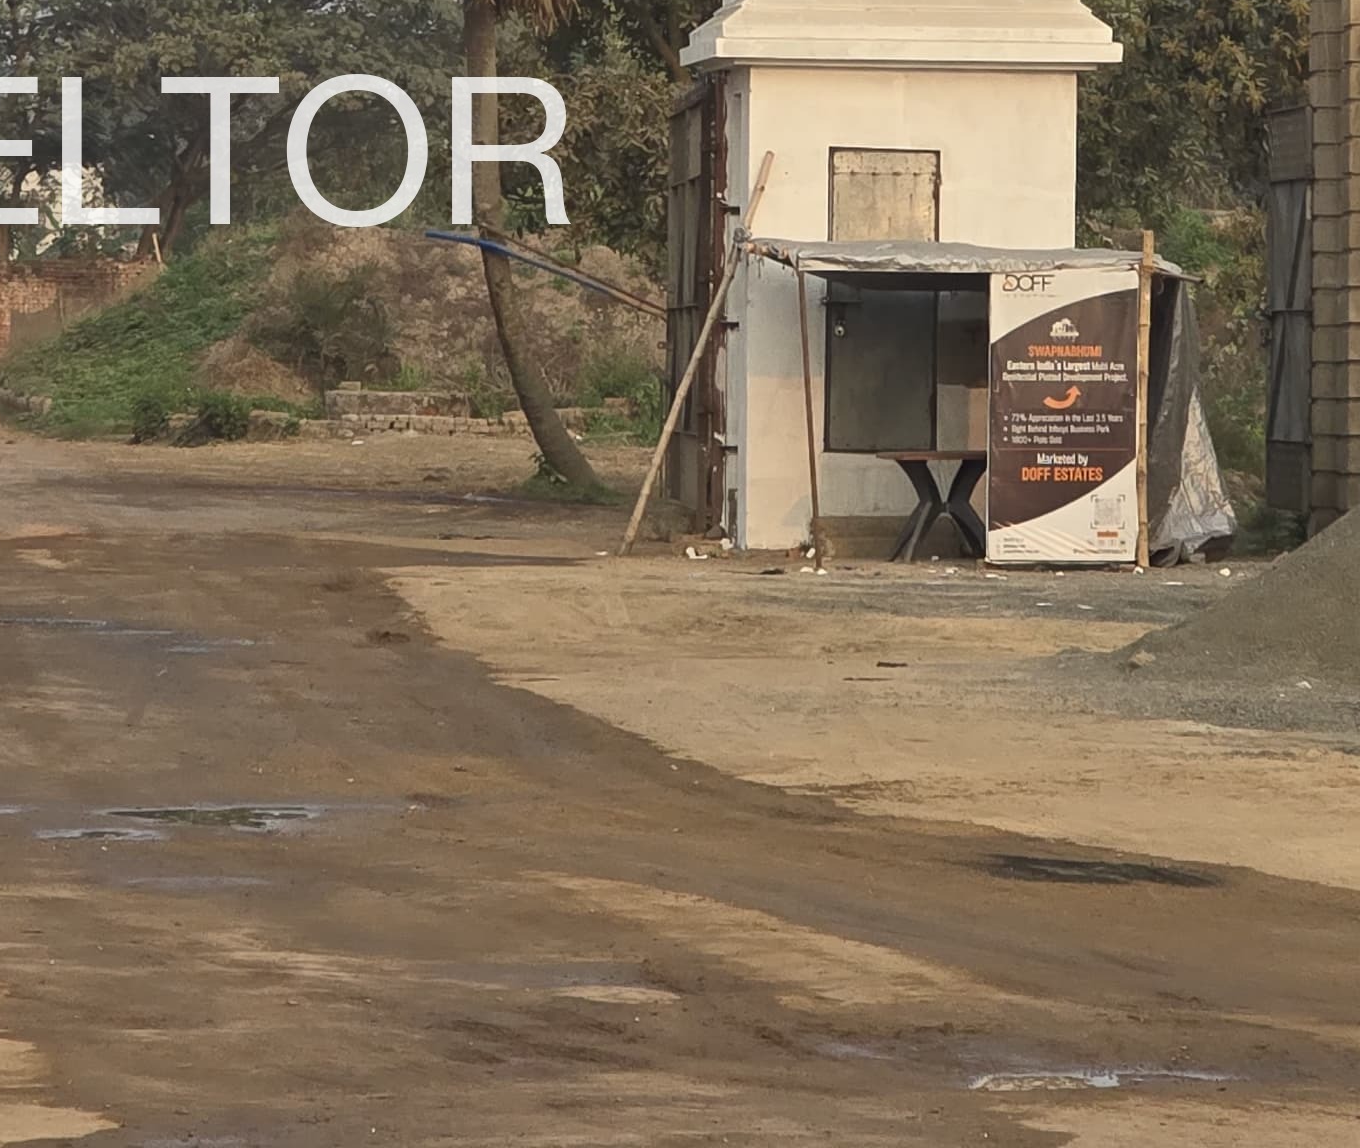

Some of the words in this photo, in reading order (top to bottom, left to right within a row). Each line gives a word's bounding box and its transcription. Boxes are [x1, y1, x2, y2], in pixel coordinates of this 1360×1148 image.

[1002, 274, 1055, 292] DOFF
[1063, 360, 1091, 372] Largest
[1037, 452, 1076, 465] Marketed
[1077, 452, 1088, 466] by
[1021, 466, 1051, 482] DOFF
[1053, 466, 1103, 482] ESTATES
